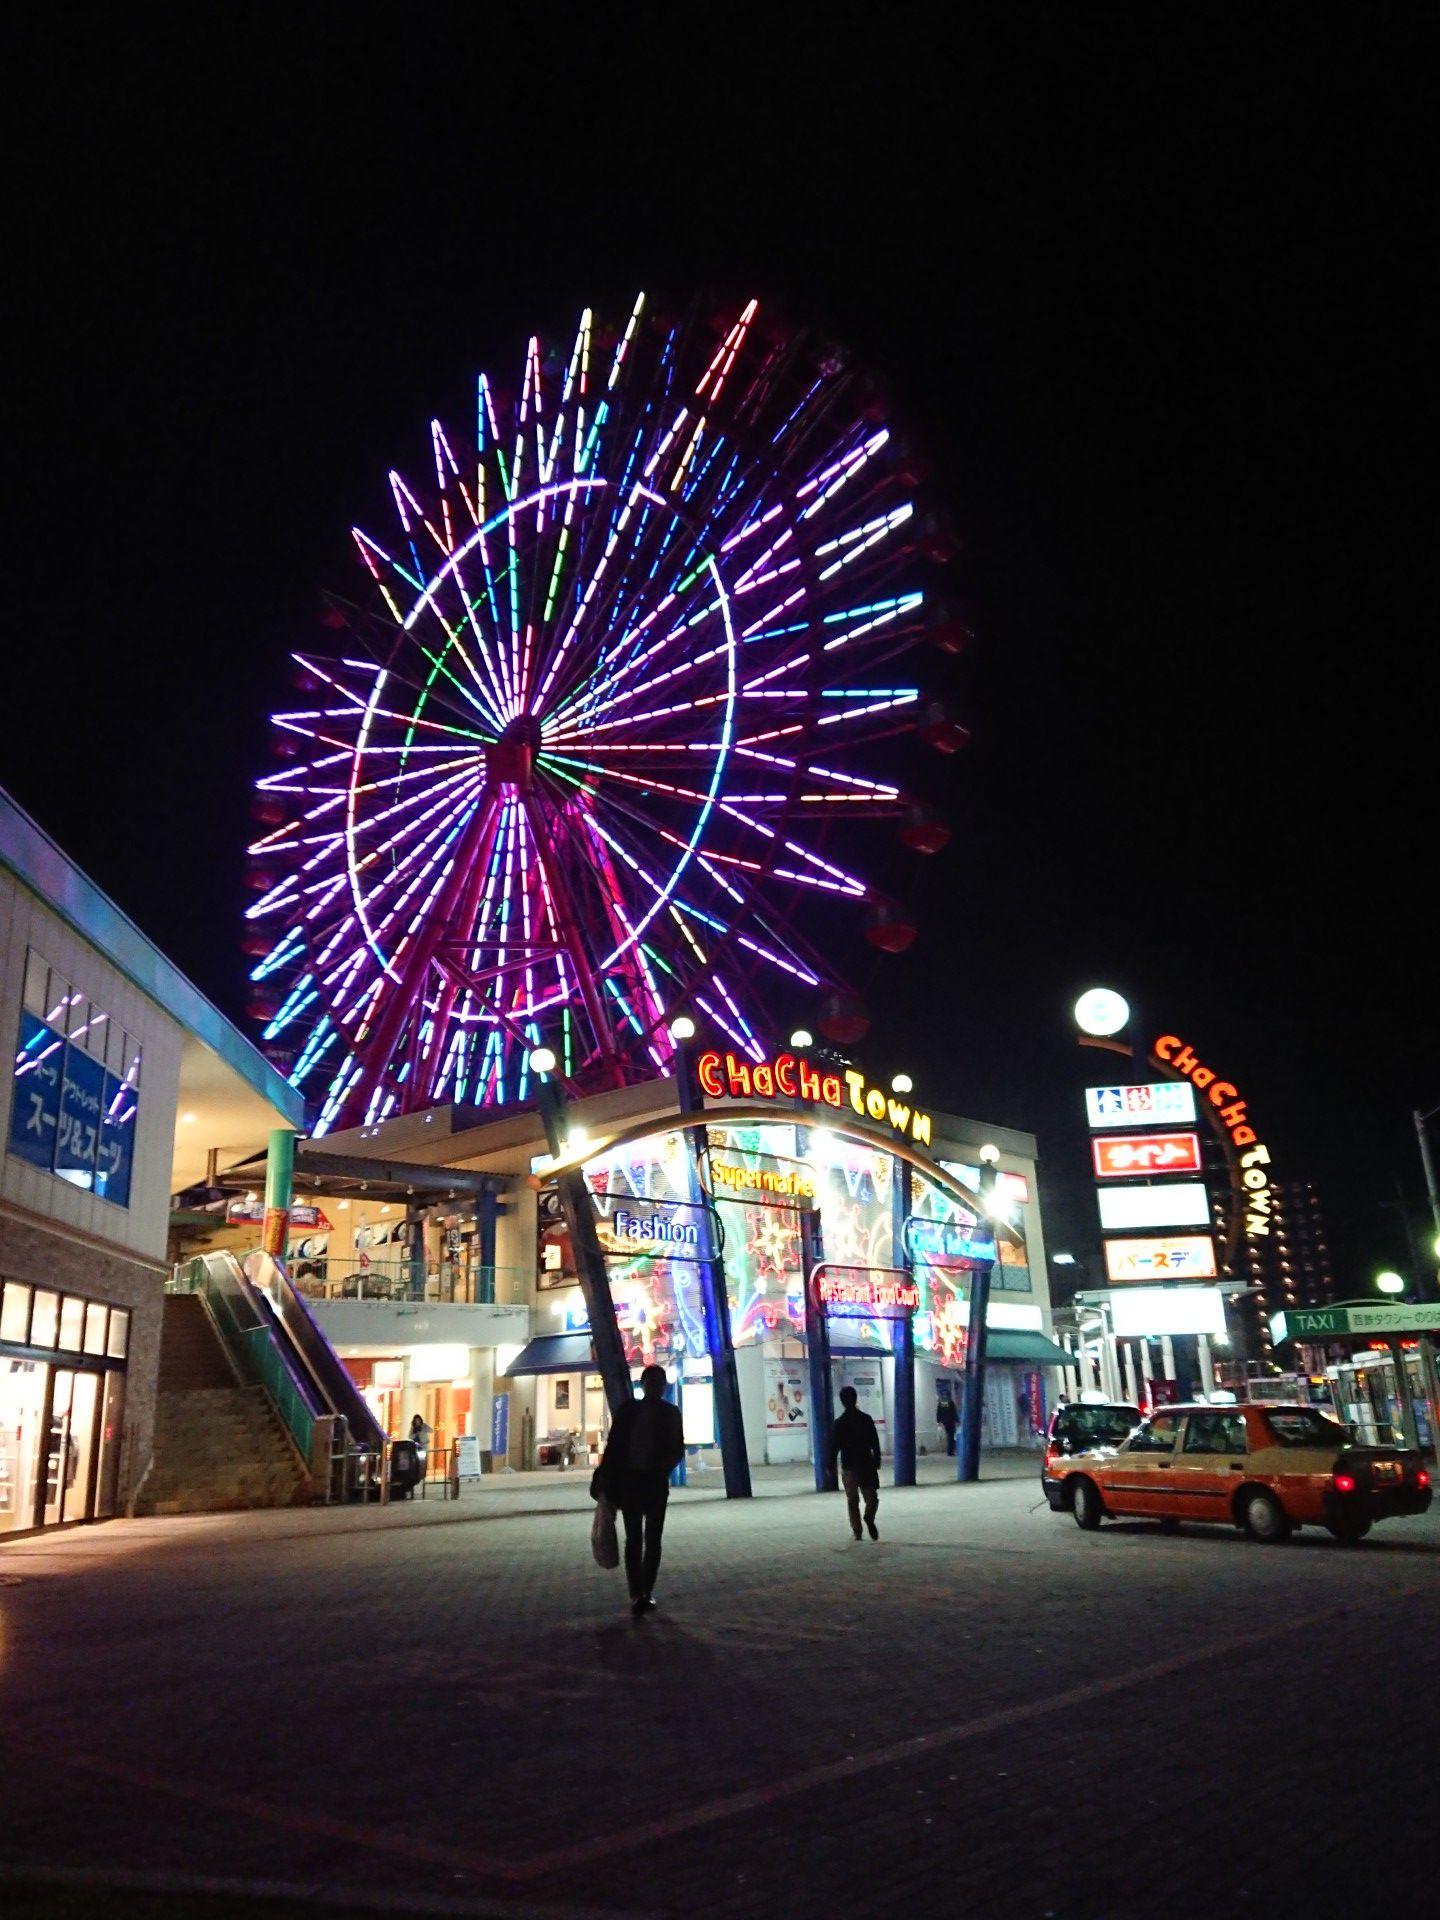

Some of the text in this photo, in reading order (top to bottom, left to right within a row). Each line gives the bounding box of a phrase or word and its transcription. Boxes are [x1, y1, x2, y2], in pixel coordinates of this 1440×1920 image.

[711, 1159, 818, 1199] Supermarke
[613, 1209, 699, 1244] Fashion
[1295, 1314, 1335, 1331] TAXI
